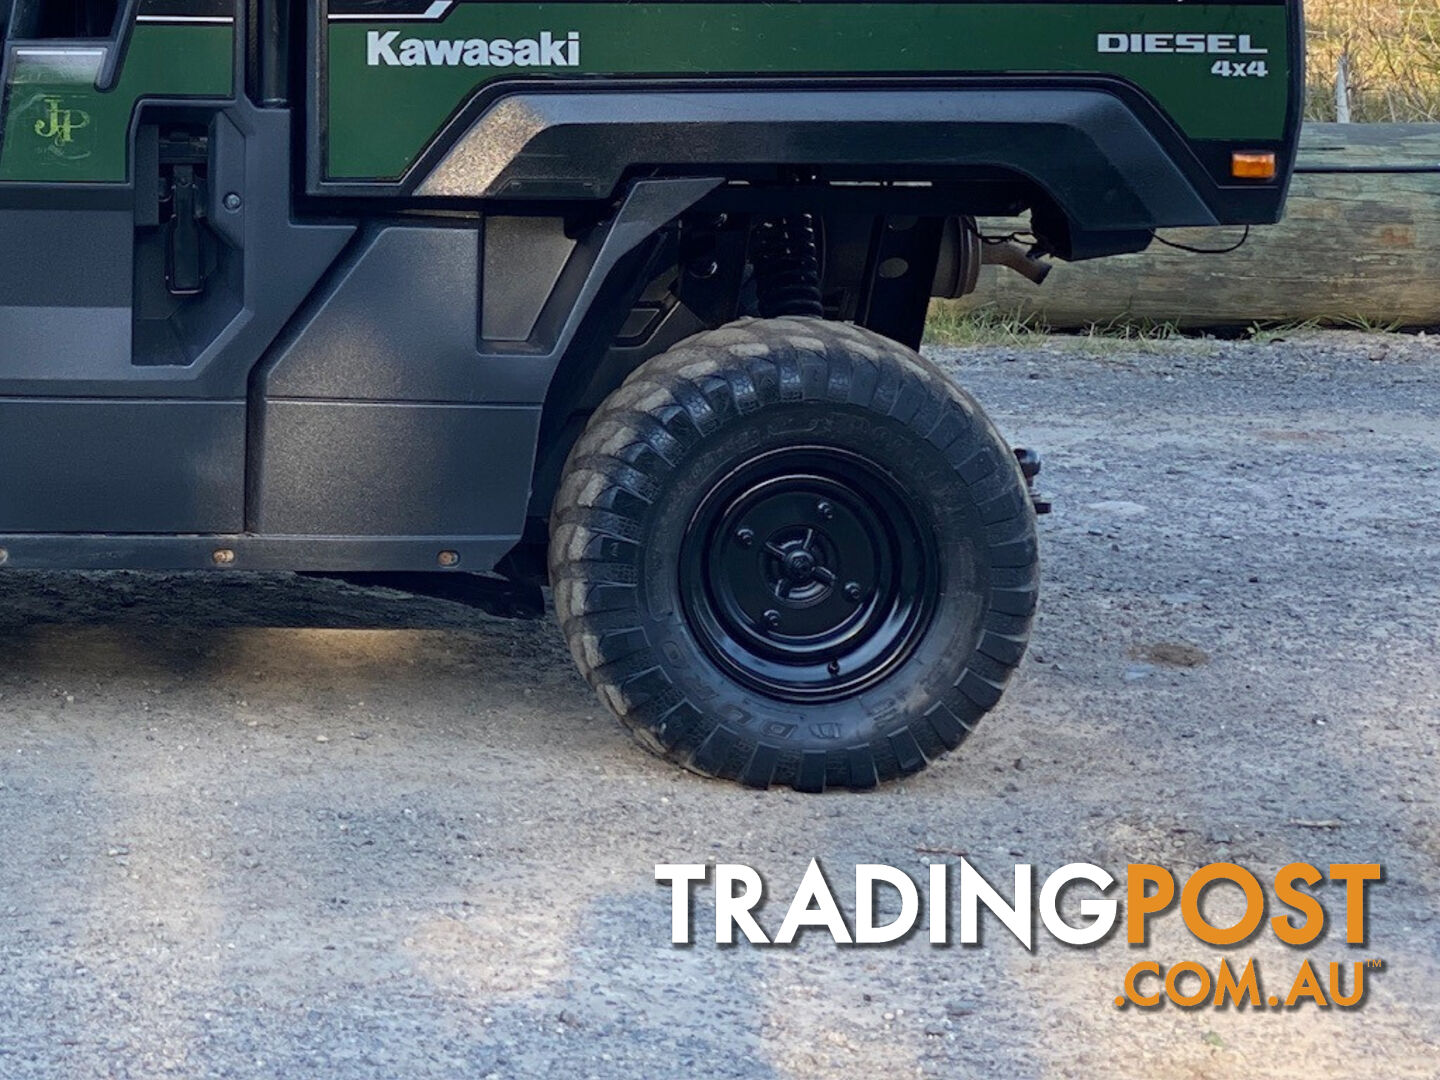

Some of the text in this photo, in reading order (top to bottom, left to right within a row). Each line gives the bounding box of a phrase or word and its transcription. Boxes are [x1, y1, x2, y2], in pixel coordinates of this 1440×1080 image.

[367, 30, 580, 67] Kawasaki
[1097, 33, 1268, 54] DIESEL
[1211, 60, 1268, 77] 4x4
